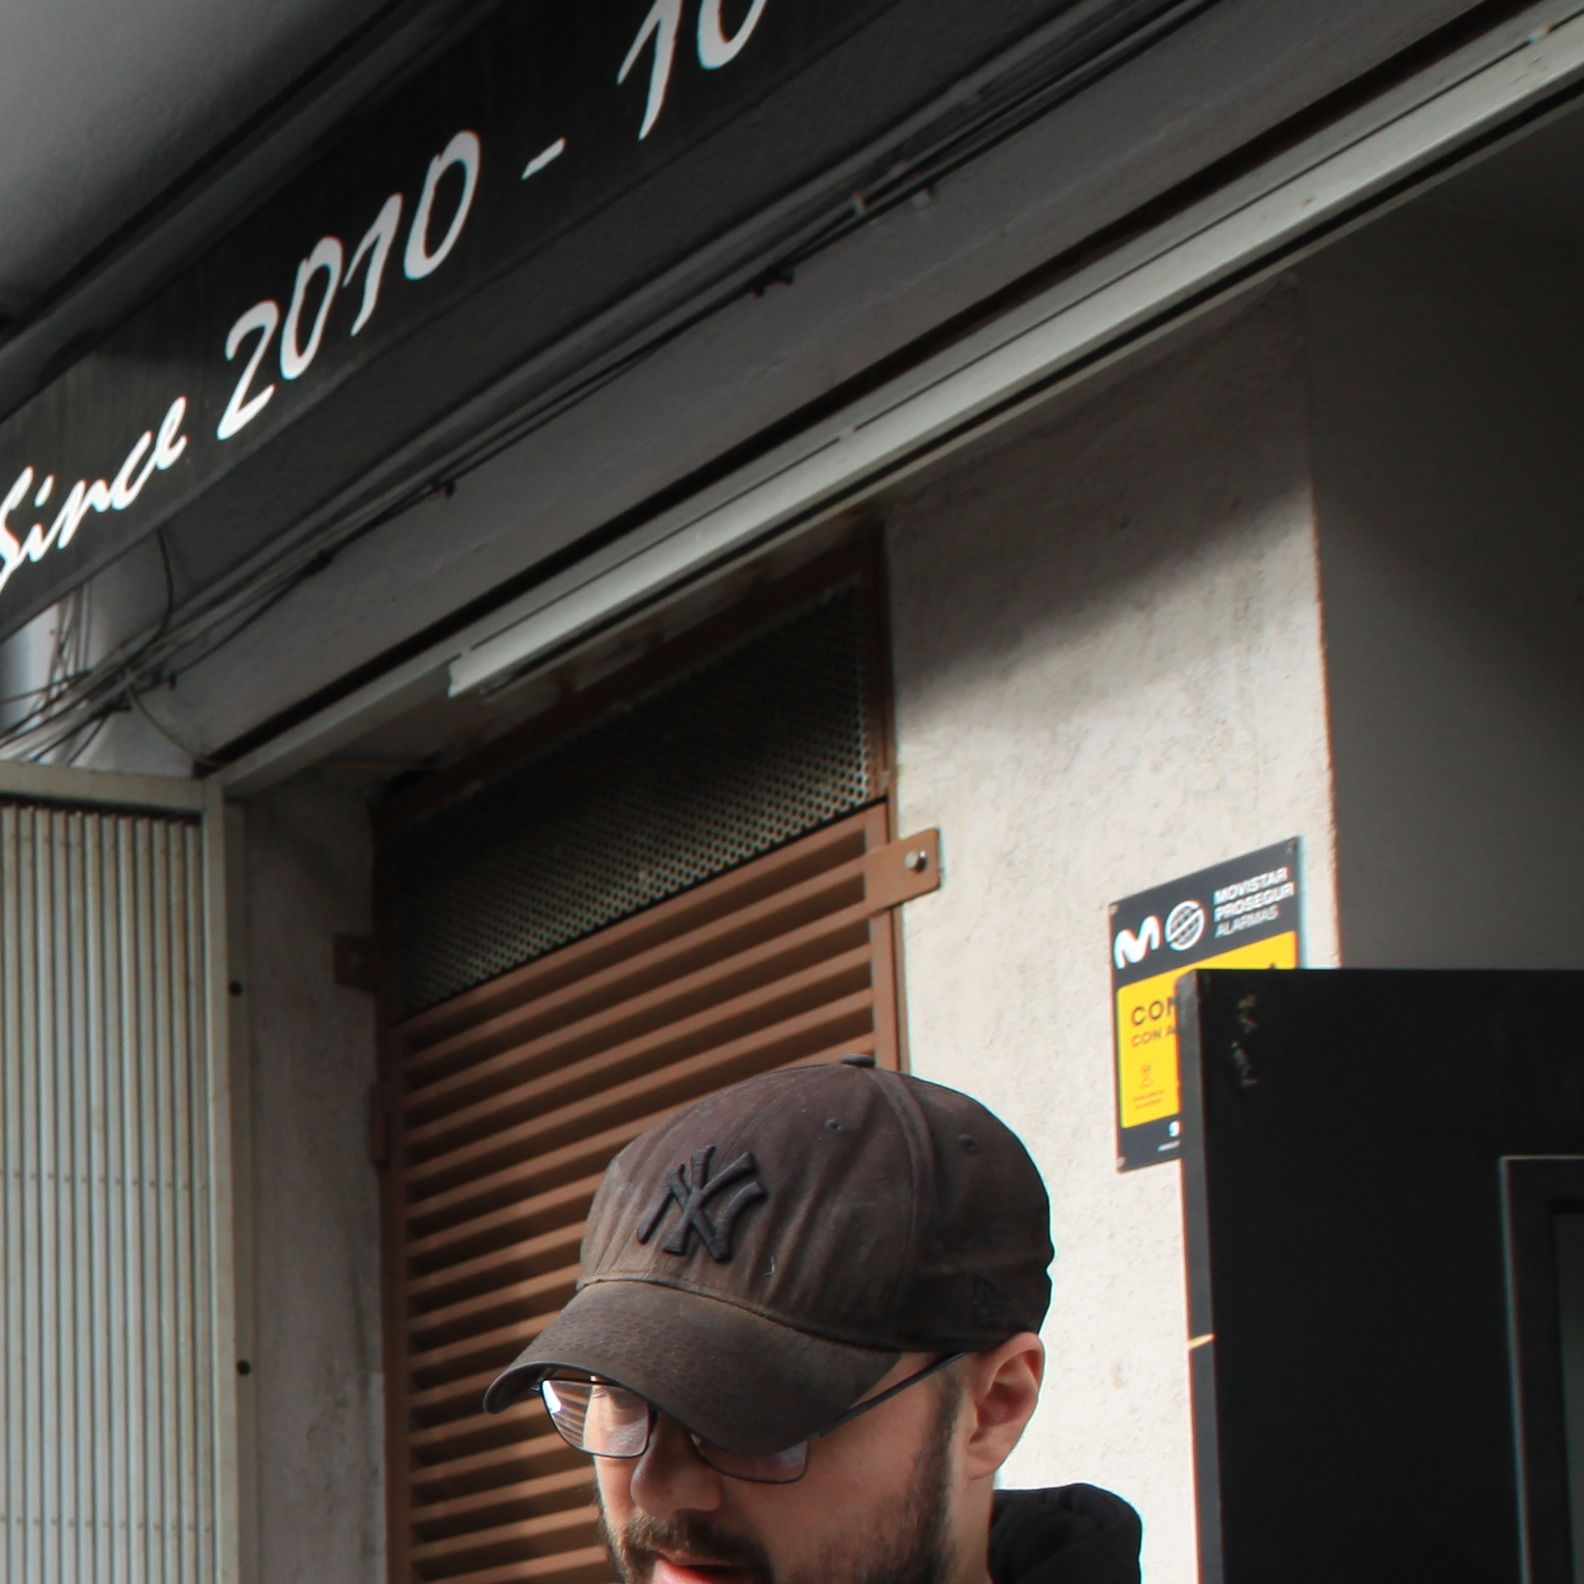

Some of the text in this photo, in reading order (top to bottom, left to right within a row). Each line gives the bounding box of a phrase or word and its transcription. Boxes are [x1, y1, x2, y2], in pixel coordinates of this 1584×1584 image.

[217, 130, 480, 440] 2010
[1213, 866, 1290, 906] MOVISTAR
[1213, 881, 1296, 922] PROSEGUR
[1214, 903, 1280, 938] ALARMAS
